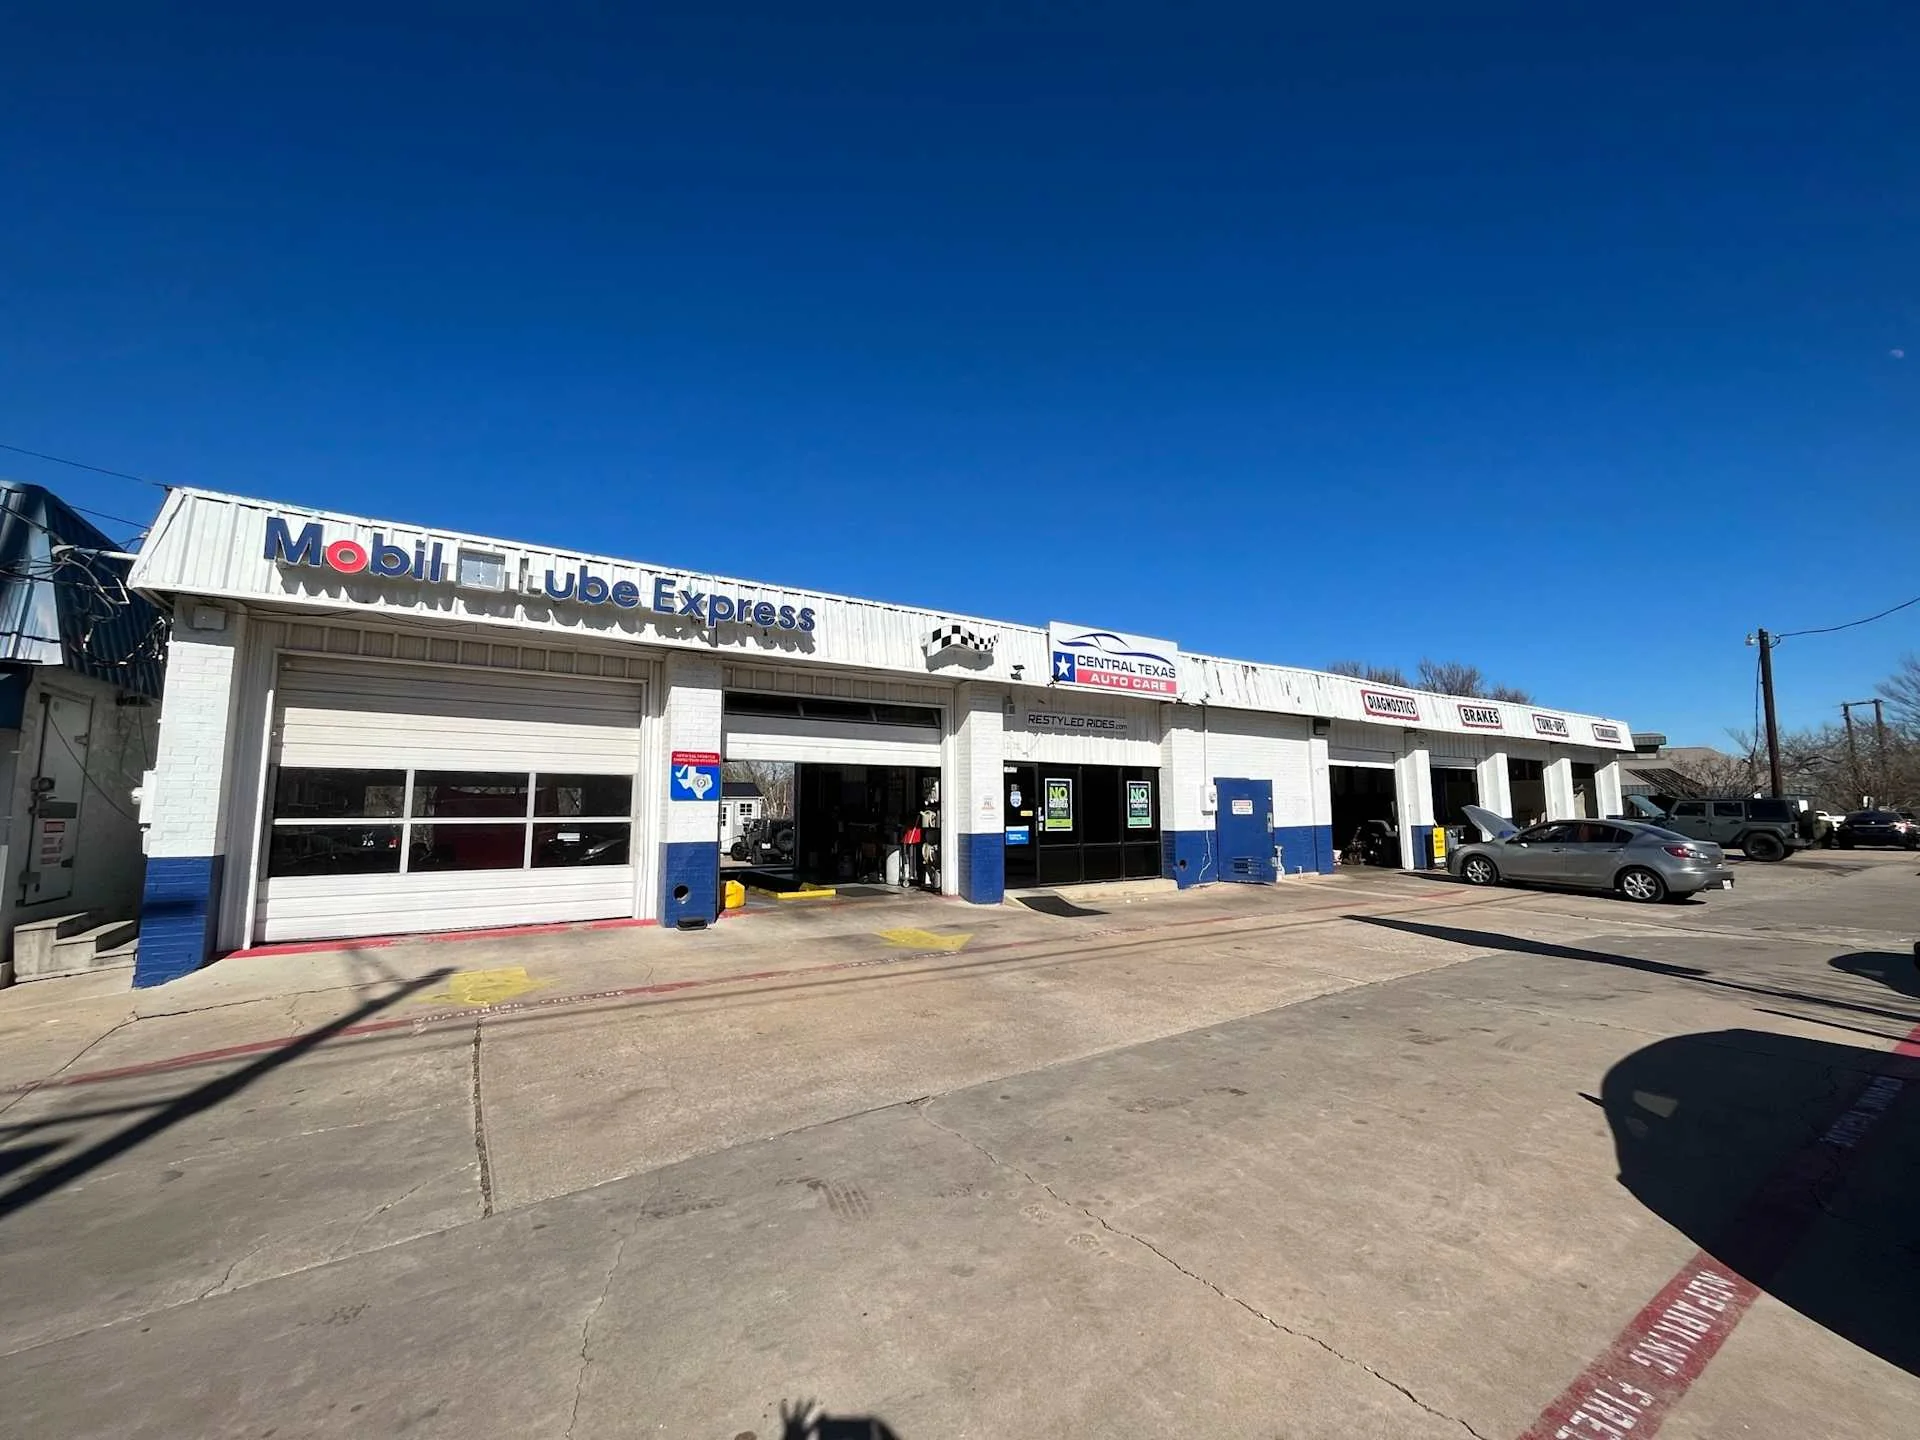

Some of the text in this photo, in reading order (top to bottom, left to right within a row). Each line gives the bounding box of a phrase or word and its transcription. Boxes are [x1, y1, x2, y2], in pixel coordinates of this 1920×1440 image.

[264, 515, 443, 583] Mobil
[653, 577, 816, 632] Express
[1077, 655, 1176, 679] CENTRAL TEXAS
[1090, 673, 1167, 691] AUTO CARE
[1367, 695, 1416, 715] DIAGNOSTICS
[1028, 714, 1085, 727] RESTYLED
[1463, 708, 1500, 724] BRAKES
[1049, 787, 1068, 800] NO
[1130, 788, 1147, 801] NO
[1629, 1288, 1726, 1375] PARKING
